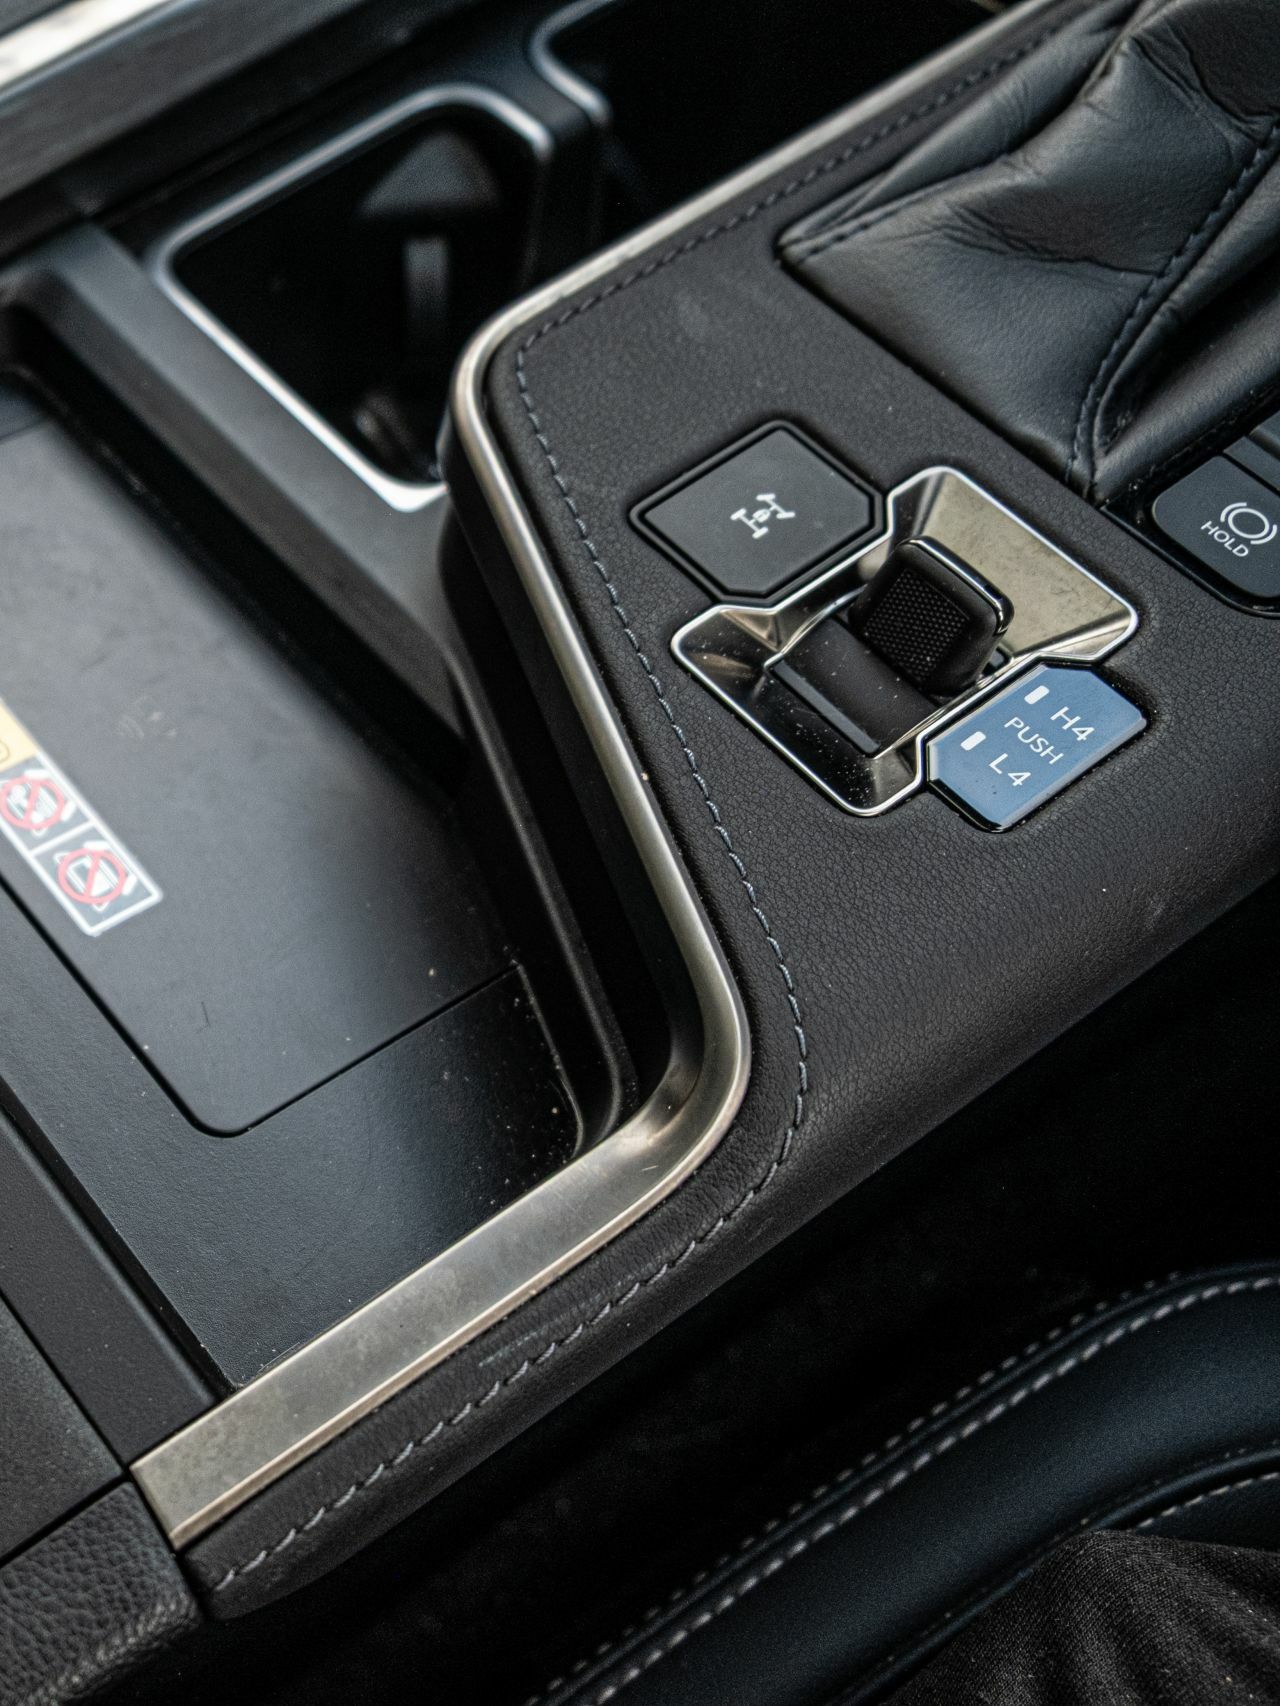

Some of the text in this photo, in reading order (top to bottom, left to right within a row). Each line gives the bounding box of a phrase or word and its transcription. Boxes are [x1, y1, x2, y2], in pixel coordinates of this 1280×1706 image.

[1200, 520, 1249, 557] HOLD
[1004, 717, 1064, 765] PUSH
[1050, 706, 1095, 741] H4
[988, 753, 1031, 786] L4
